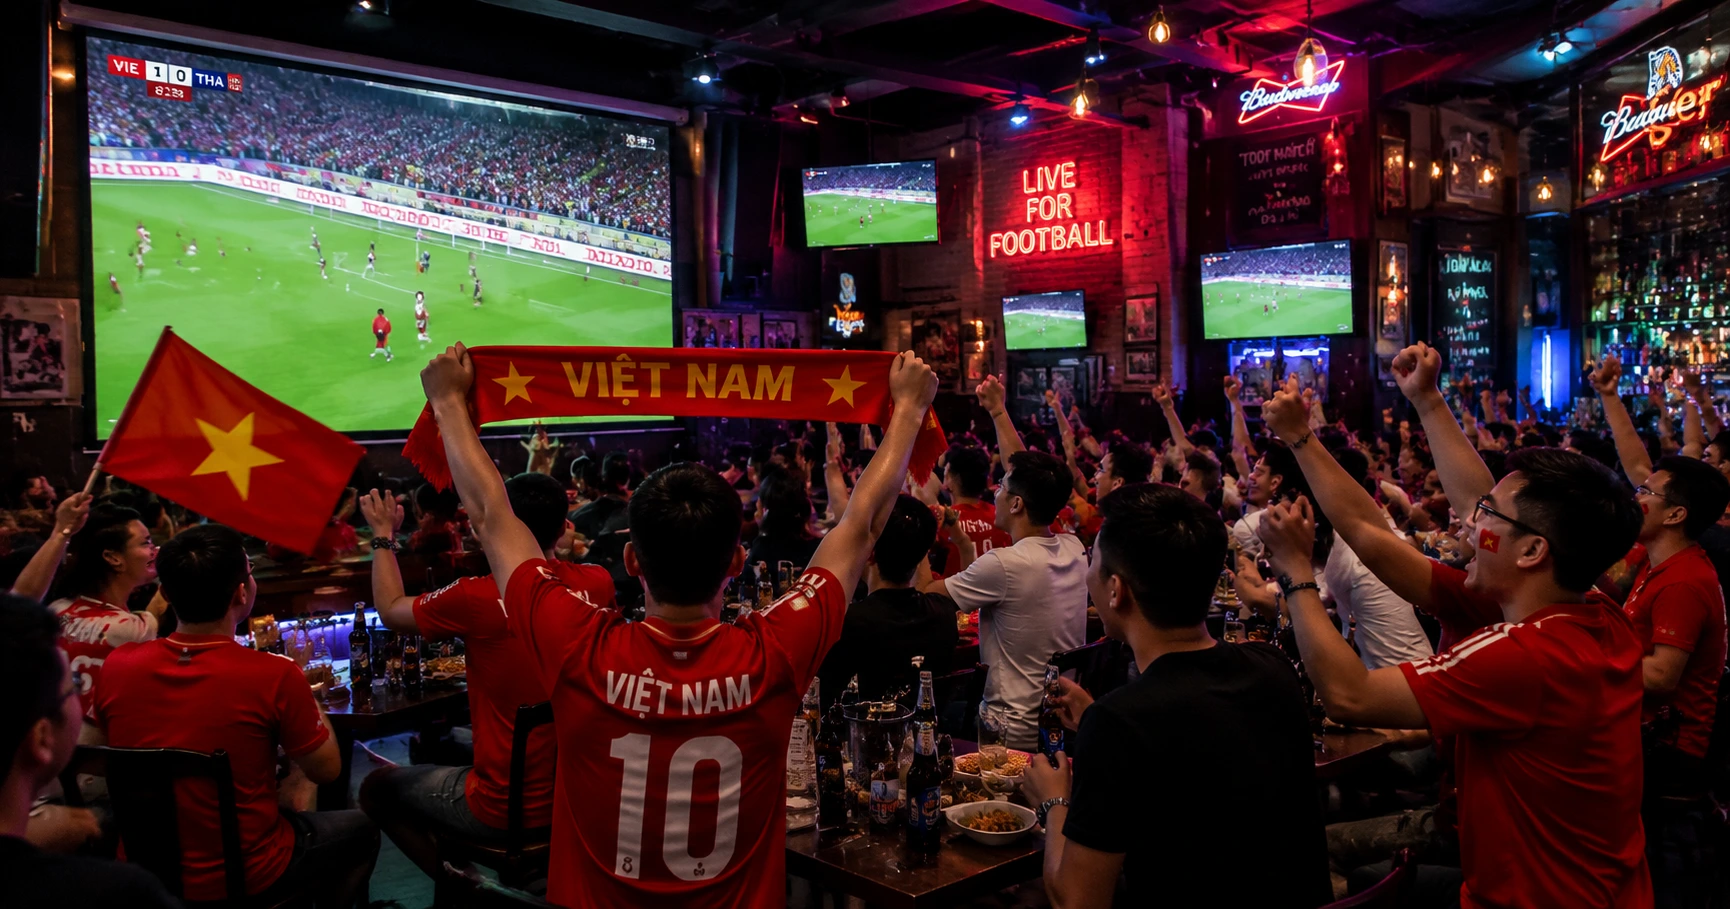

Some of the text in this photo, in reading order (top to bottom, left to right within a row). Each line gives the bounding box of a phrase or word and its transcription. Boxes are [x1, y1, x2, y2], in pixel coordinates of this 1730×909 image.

[113, 59, 139, 75] VIE
[154, 66, 161, 78] 1
[176, 69, 186, 82] 0
[195, 73, 224, 87] THA
[1023, 161, 1076, 194] LIVE
[1027, 193, 1073, 223] FOR
[990, 220, 1114, 258] FOOTBALL
[561, 353, 796, 406] VIỆT NAM
[607, 667, 752, 719] VIỆT NAM
[609, 732, 743, 882] 10
